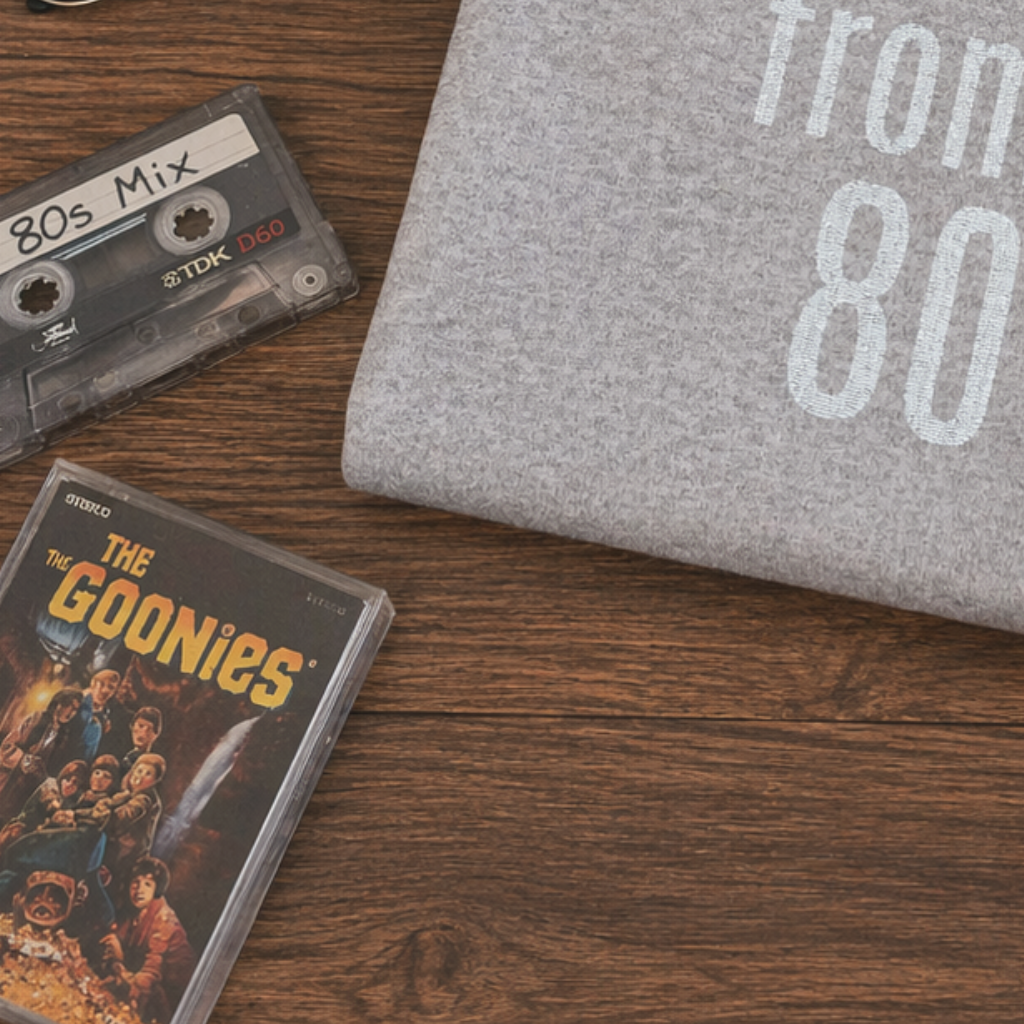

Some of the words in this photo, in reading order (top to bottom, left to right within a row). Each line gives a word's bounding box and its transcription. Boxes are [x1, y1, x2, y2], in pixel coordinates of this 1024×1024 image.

[9, 203, 93, 255] 80s
[114, 151, 199, 208] Mix
[180, 245, 232, 280] TDK
[236, 219, 285, 254] D60
[46, 549, 73, 572] THE
[100, 533, 155, 578] THE
